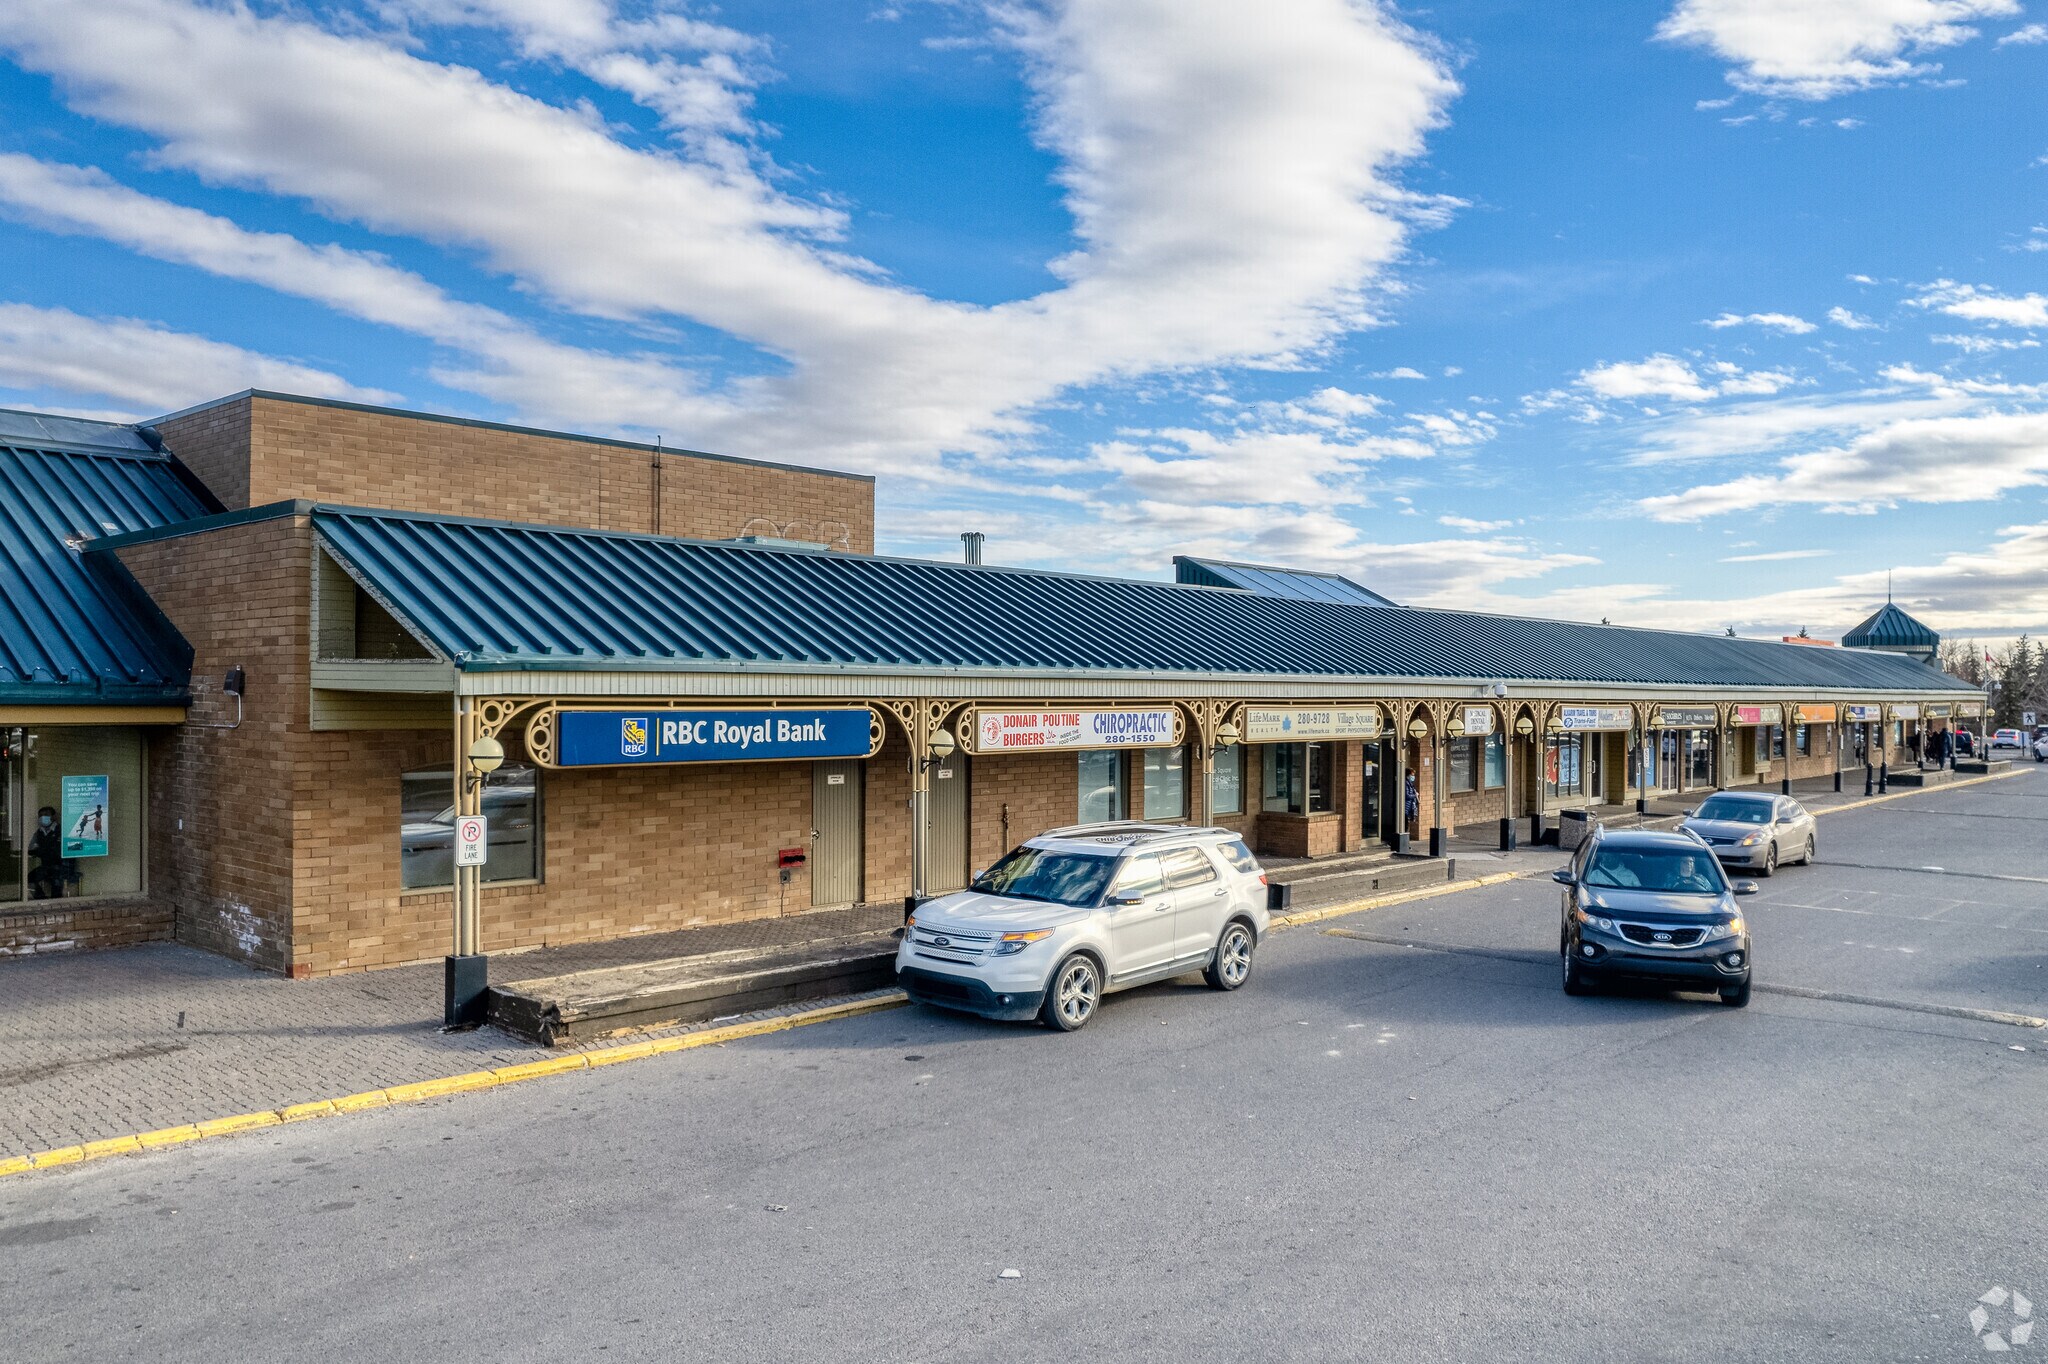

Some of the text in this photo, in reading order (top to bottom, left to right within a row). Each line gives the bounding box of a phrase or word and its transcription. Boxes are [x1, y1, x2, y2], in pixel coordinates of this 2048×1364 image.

[1003, 714, 1037, 728] DONAIR
[1043, 713, 1080, 727] POUTINE
[1093, 712, 1167, 734] CHIROPRACTIC
[1297, 712, 1330, 724] 280-9728
[662, 718, 827, 750] RBC Royal Bank
[1003, 732, 1045, 746] BURGERS
[1105, 734, 1156, 744] 280-1550
[1058, 737, 1069, 745] FOOD
[625, 744, 645, 753] RBC
